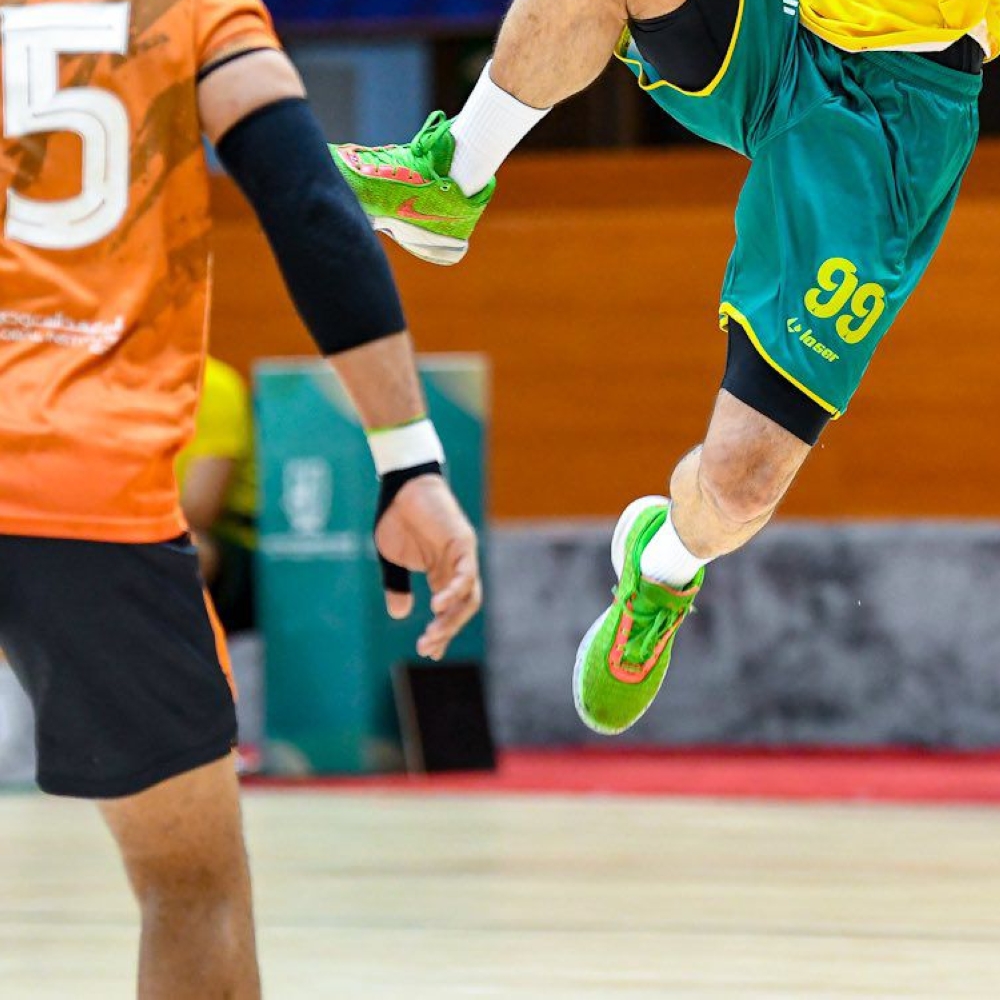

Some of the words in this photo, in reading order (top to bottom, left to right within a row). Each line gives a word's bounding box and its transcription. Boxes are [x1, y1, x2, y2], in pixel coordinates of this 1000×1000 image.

[1, 1, 131, 249] 5
[803, 256, 886, 345] 99
[799, 329, 840, 363] laser
